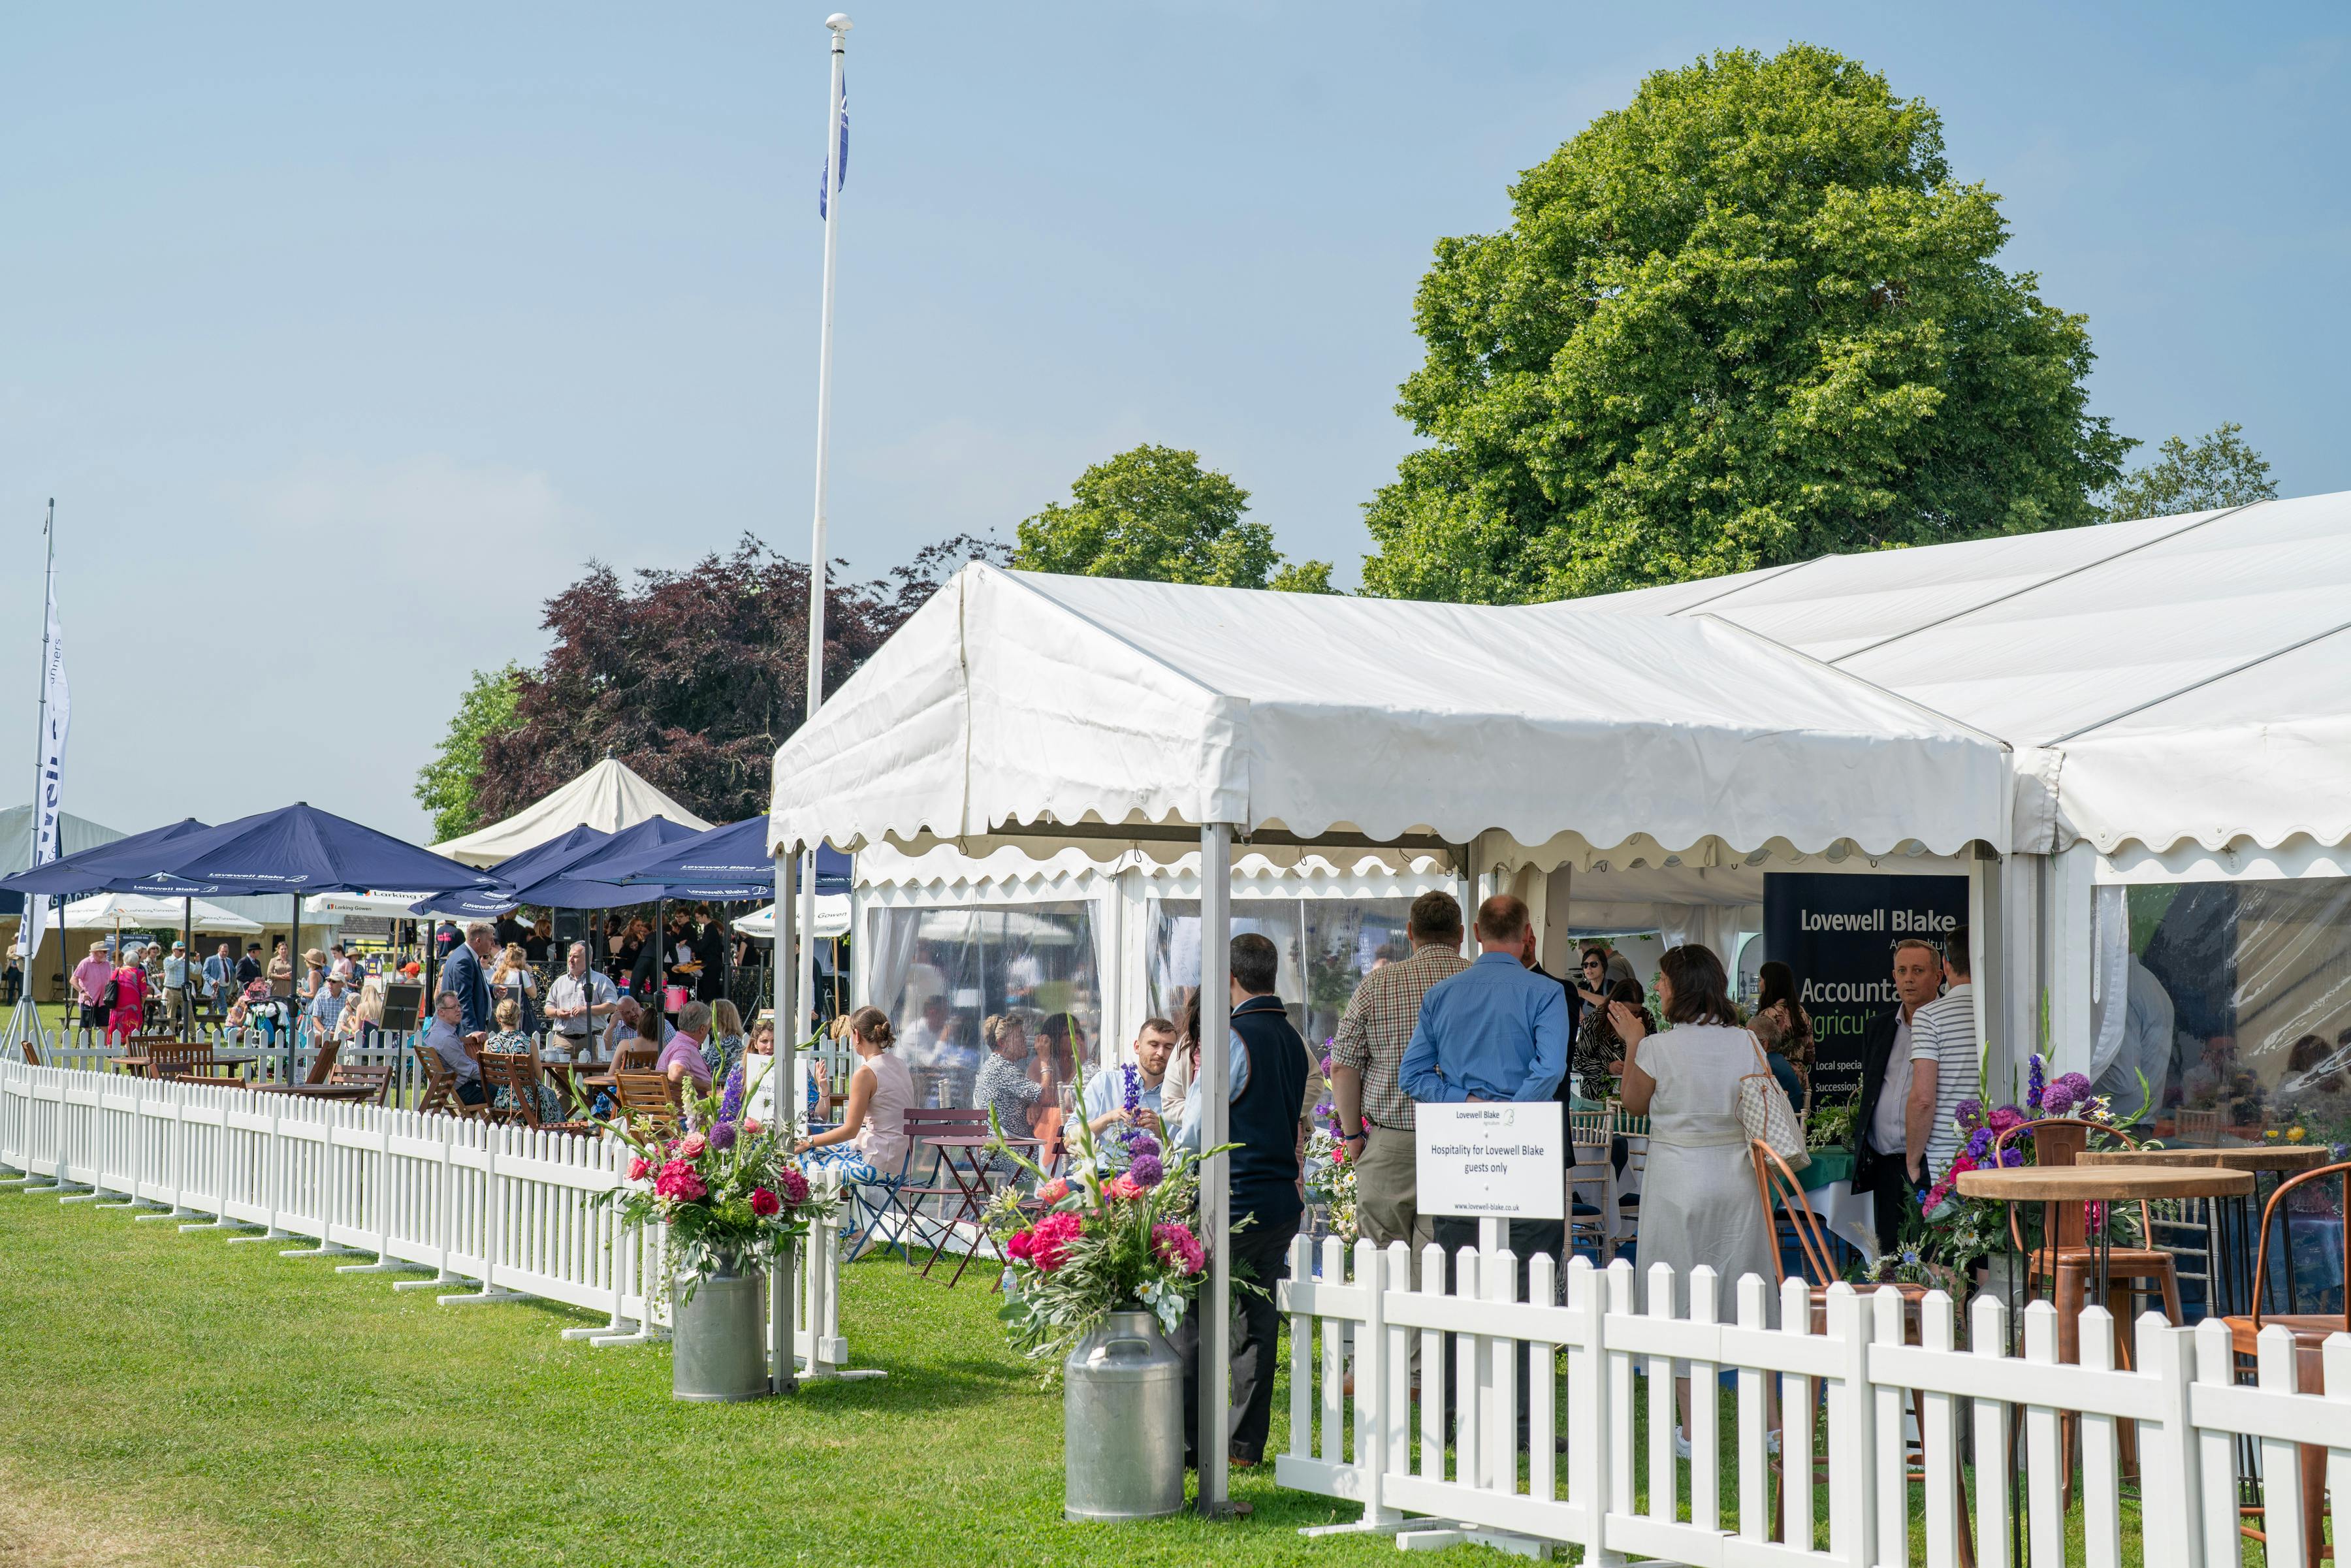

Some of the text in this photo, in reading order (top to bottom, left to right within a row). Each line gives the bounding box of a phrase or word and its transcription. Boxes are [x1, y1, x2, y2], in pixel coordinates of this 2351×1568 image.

[374, 891, 417, 899] Larking
[1801, 908, 1957, 932] Lovewell Blake
[1815, 1060, 1863, 1072] Local specia
[1815, 1081, 1857, 1092] Succession
[1456, 1110, 1500, 1119] Lovewell Blake
[1431, 1144, 1544, 1157] Hospitality for Lovewell Blake
[1465, 1162, 1507, 1175] guests only
[1454, 1202, 1520, 1211] www.lovewell-blake.co.uk
